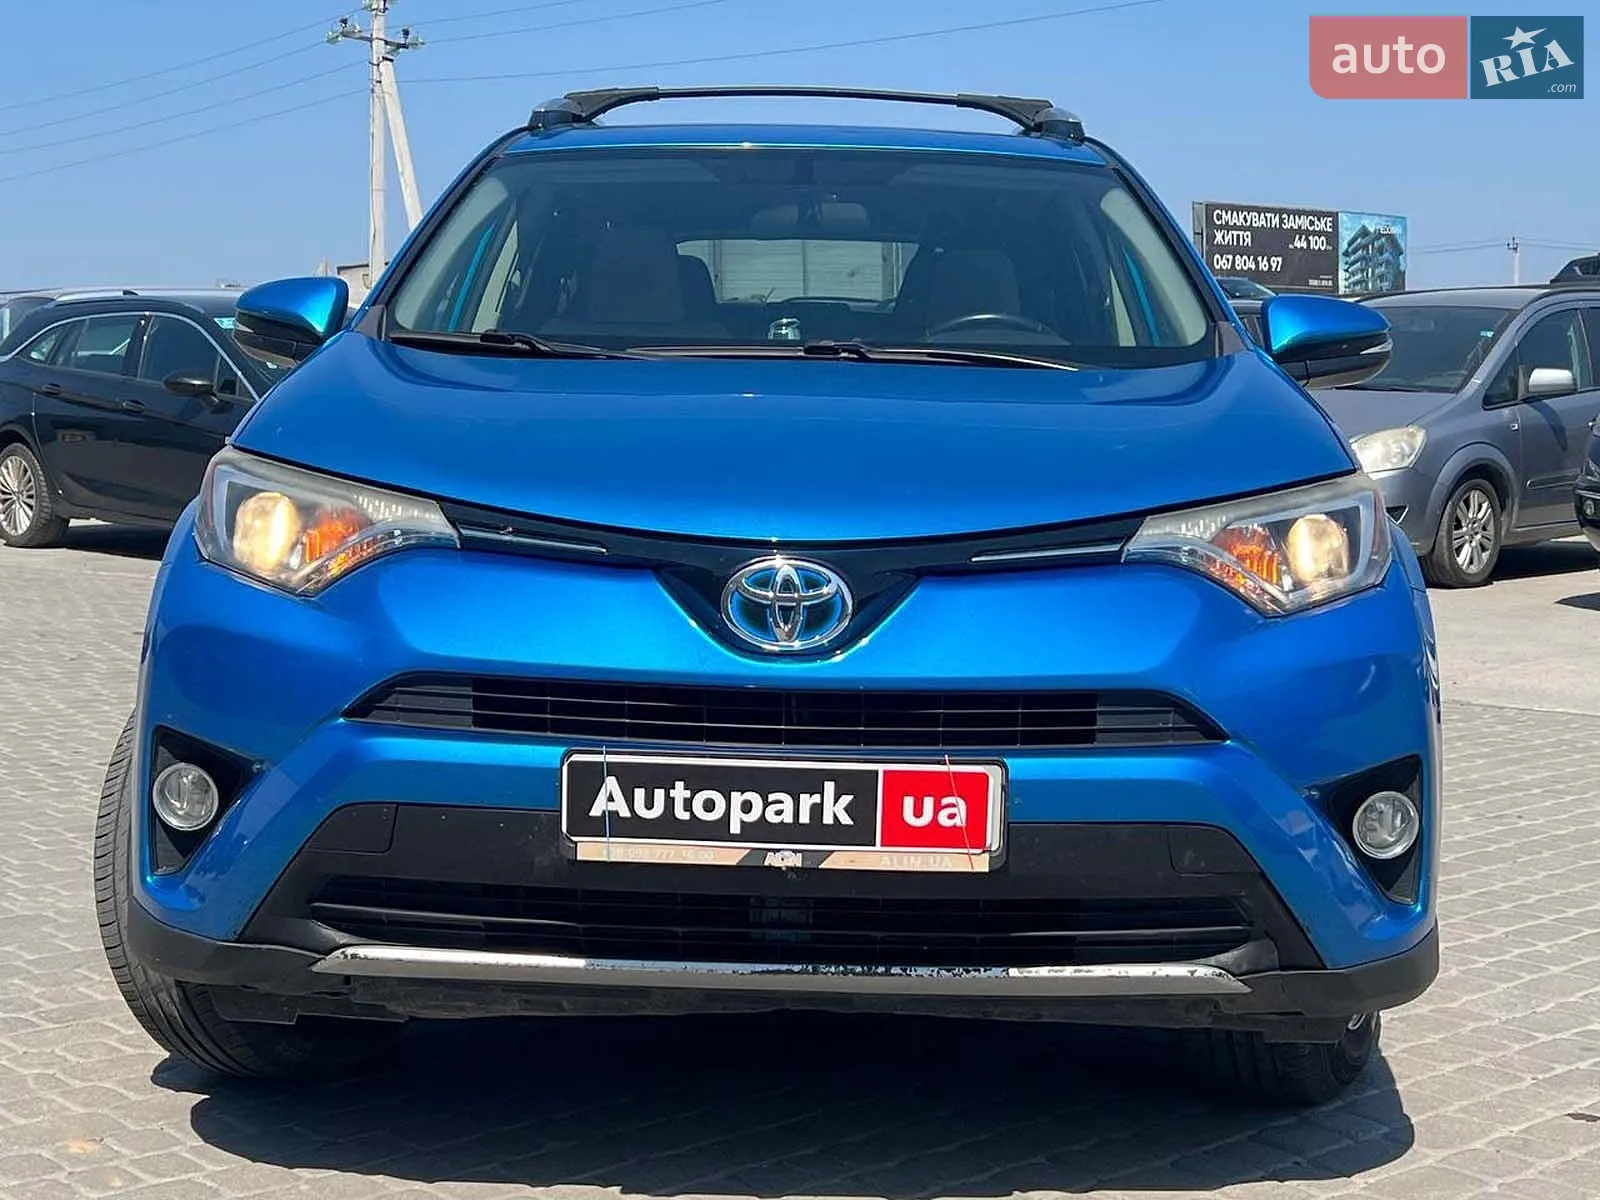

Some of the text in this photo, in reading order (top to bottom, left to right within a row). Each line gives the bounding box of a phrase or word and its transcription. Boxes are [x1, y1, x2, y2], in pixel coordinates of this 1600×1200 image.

[1213, 209, 1333, 233] СМАКУВАТИ ЗАМІСЬКЕ
[1213, 229, 1252, 247] ЖИТТЯ
[1293, 234, 1327, 251] 44 100
[1213, 254, 1283, 272] 067 804 16 97
[589, 775, 967, 834] Autopark ua
